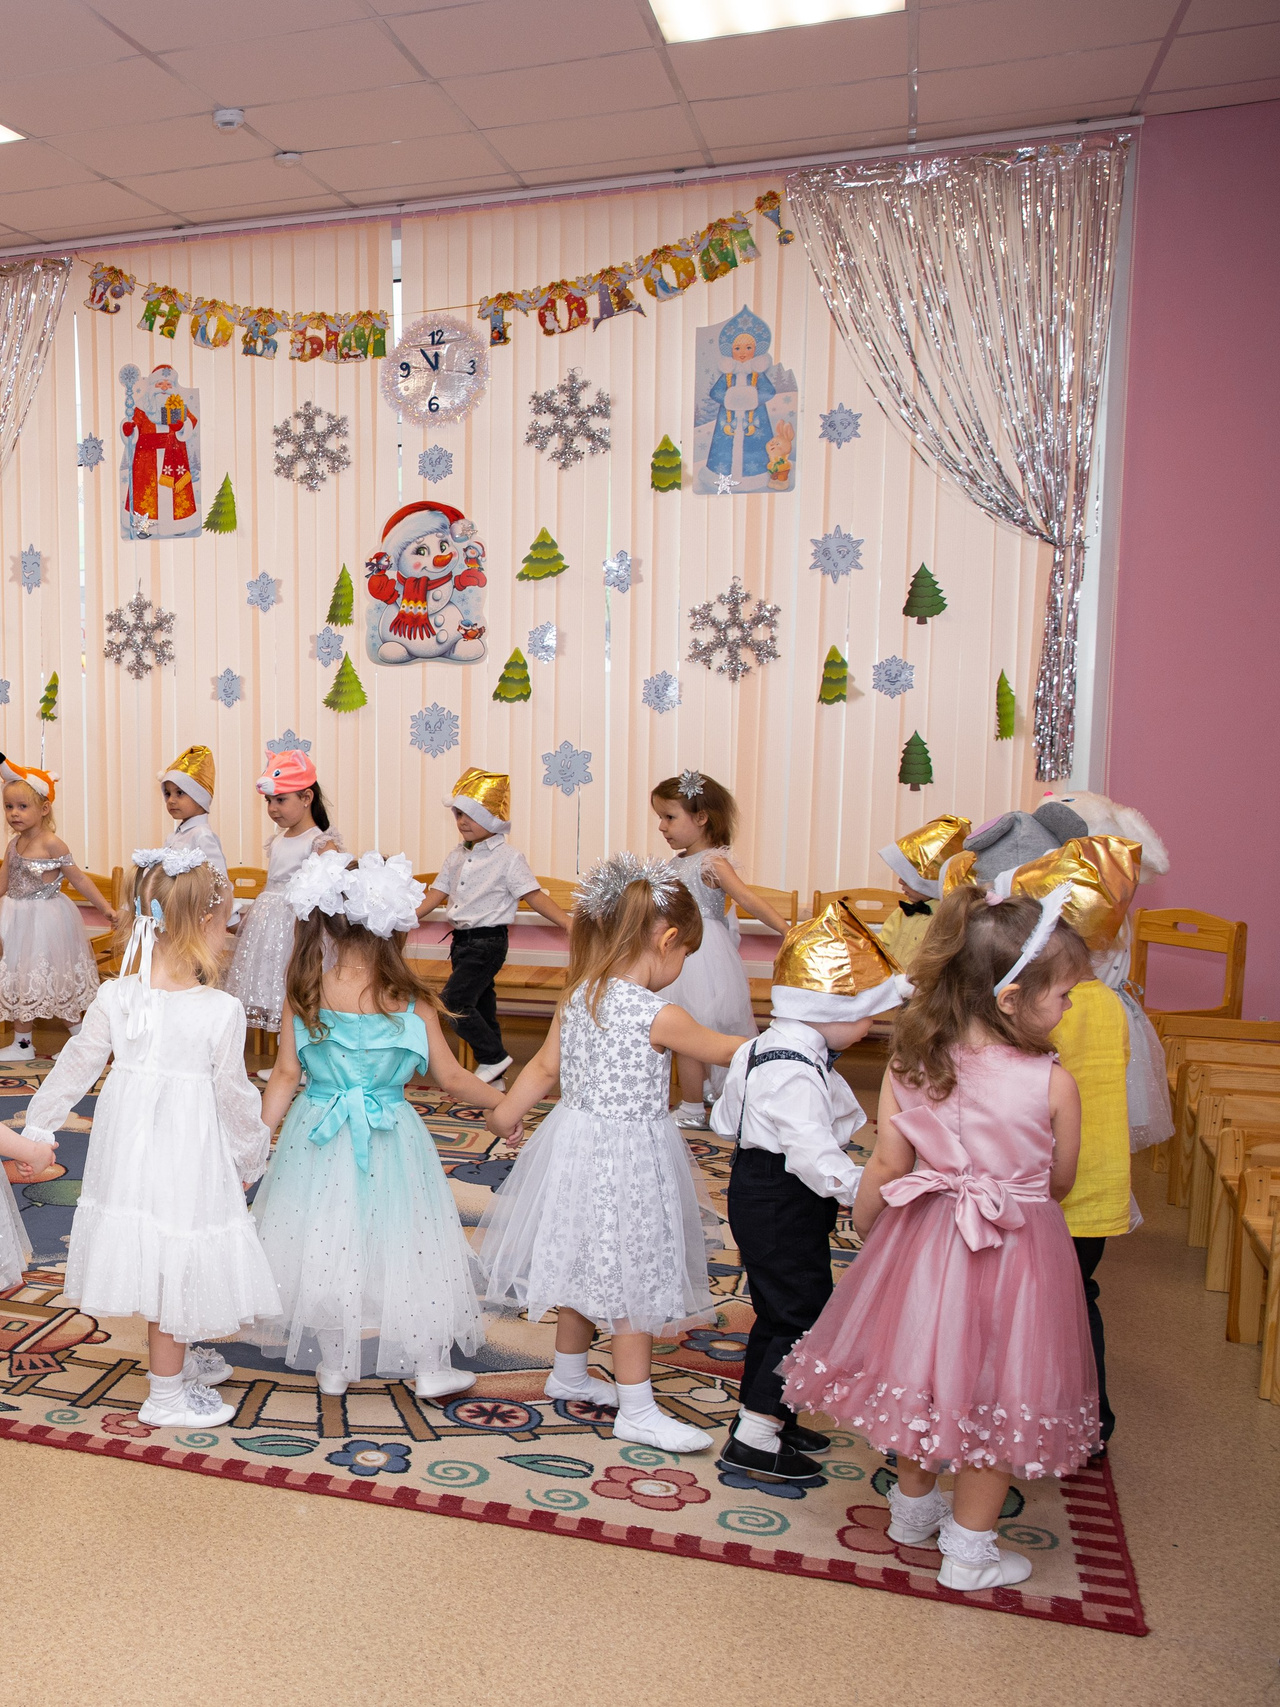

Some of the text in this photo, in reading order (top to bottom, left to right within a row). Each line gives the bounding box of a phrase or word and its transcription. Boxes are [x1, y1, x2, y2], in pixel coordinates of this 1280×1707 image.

[137, 293, 387, 363] НОВЫМ
[428, 329, 446, 346] 12
[399, 362, 411, 378] 9
[466, 359, 477, 376] 3
[427, 396, 440, 413] 6
